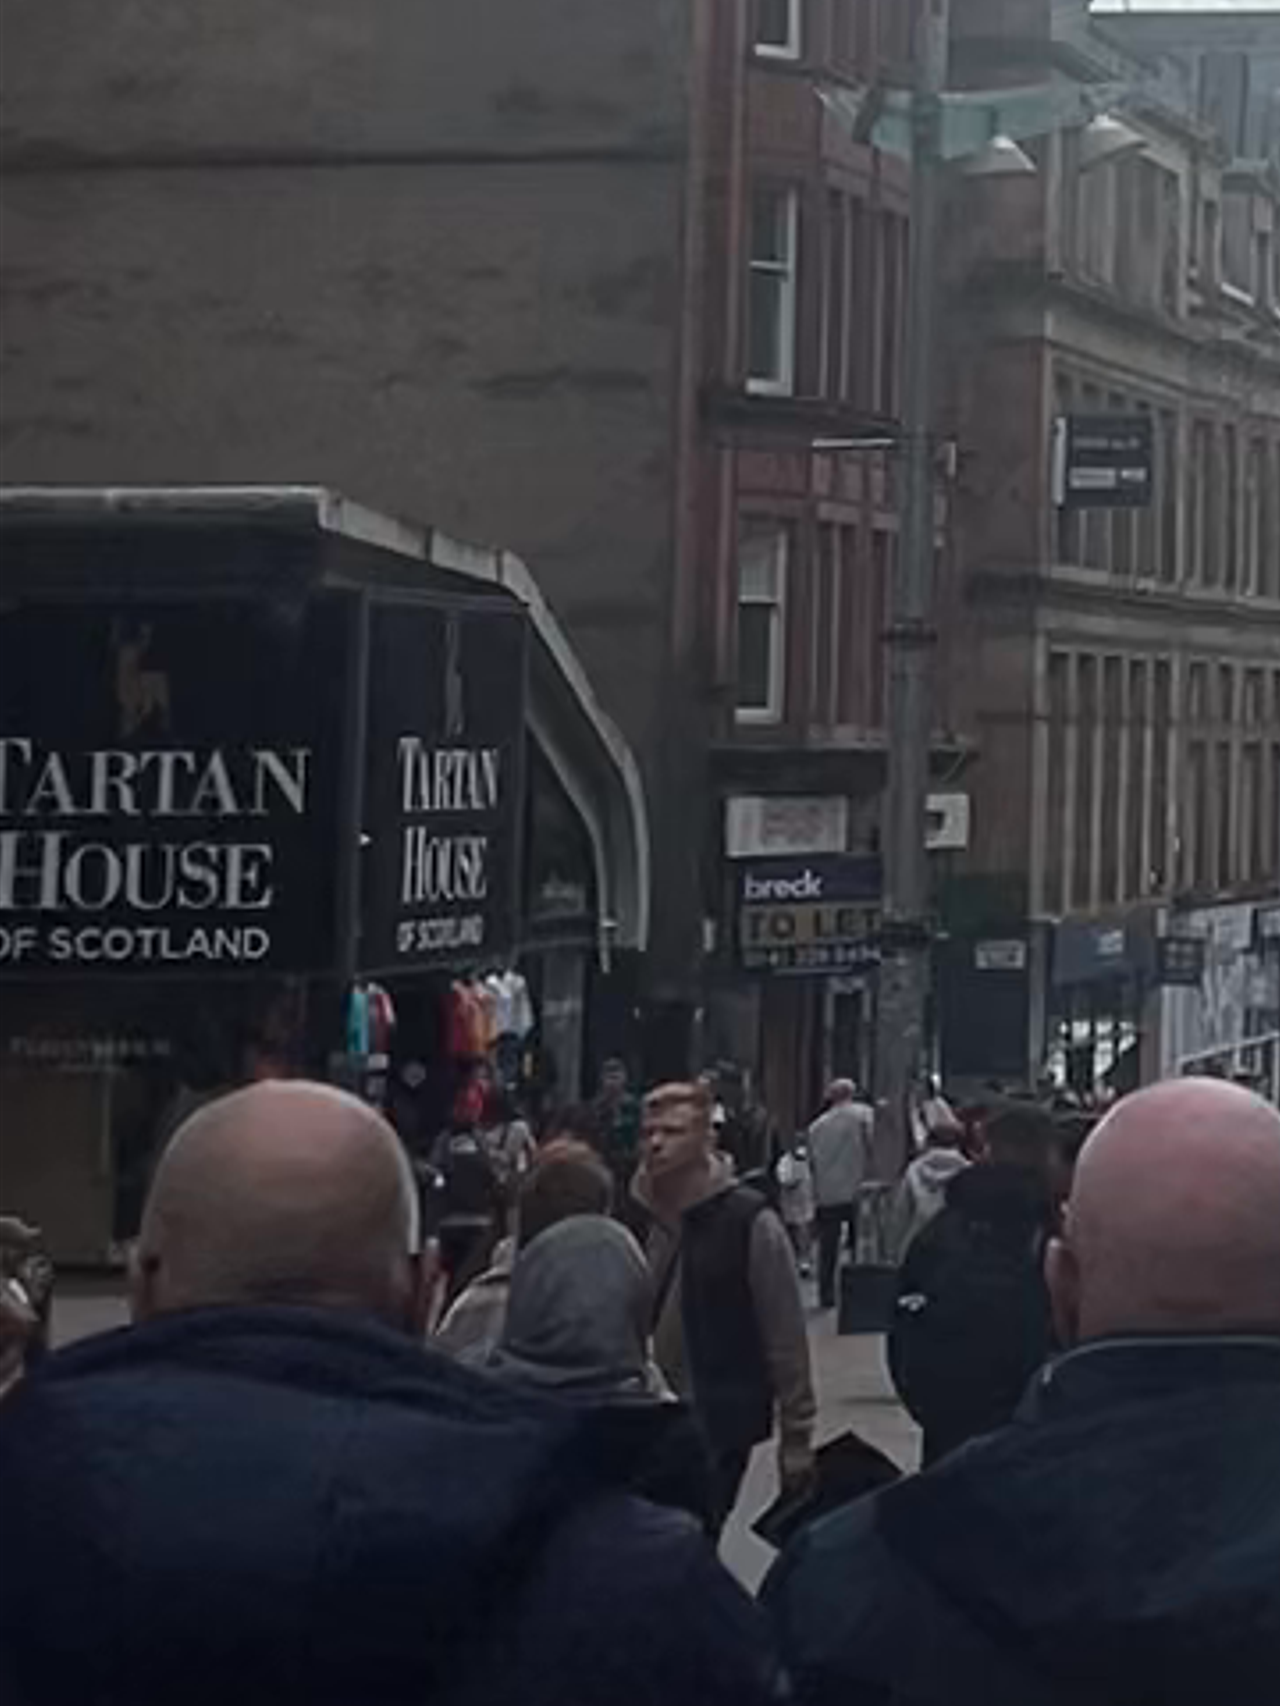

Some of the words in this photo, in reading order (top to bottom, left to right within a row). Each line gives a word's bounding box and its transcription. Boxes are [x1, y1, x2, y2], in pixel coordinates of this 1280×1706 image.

[0, 830, 273, 910] HOUSE
[403, 826, 486, 903] HOUSE
[744, 869, 823, 899] breck
[749, 910, 795, 941] TO
[50, 926, 270, 961] SCOTLAND
